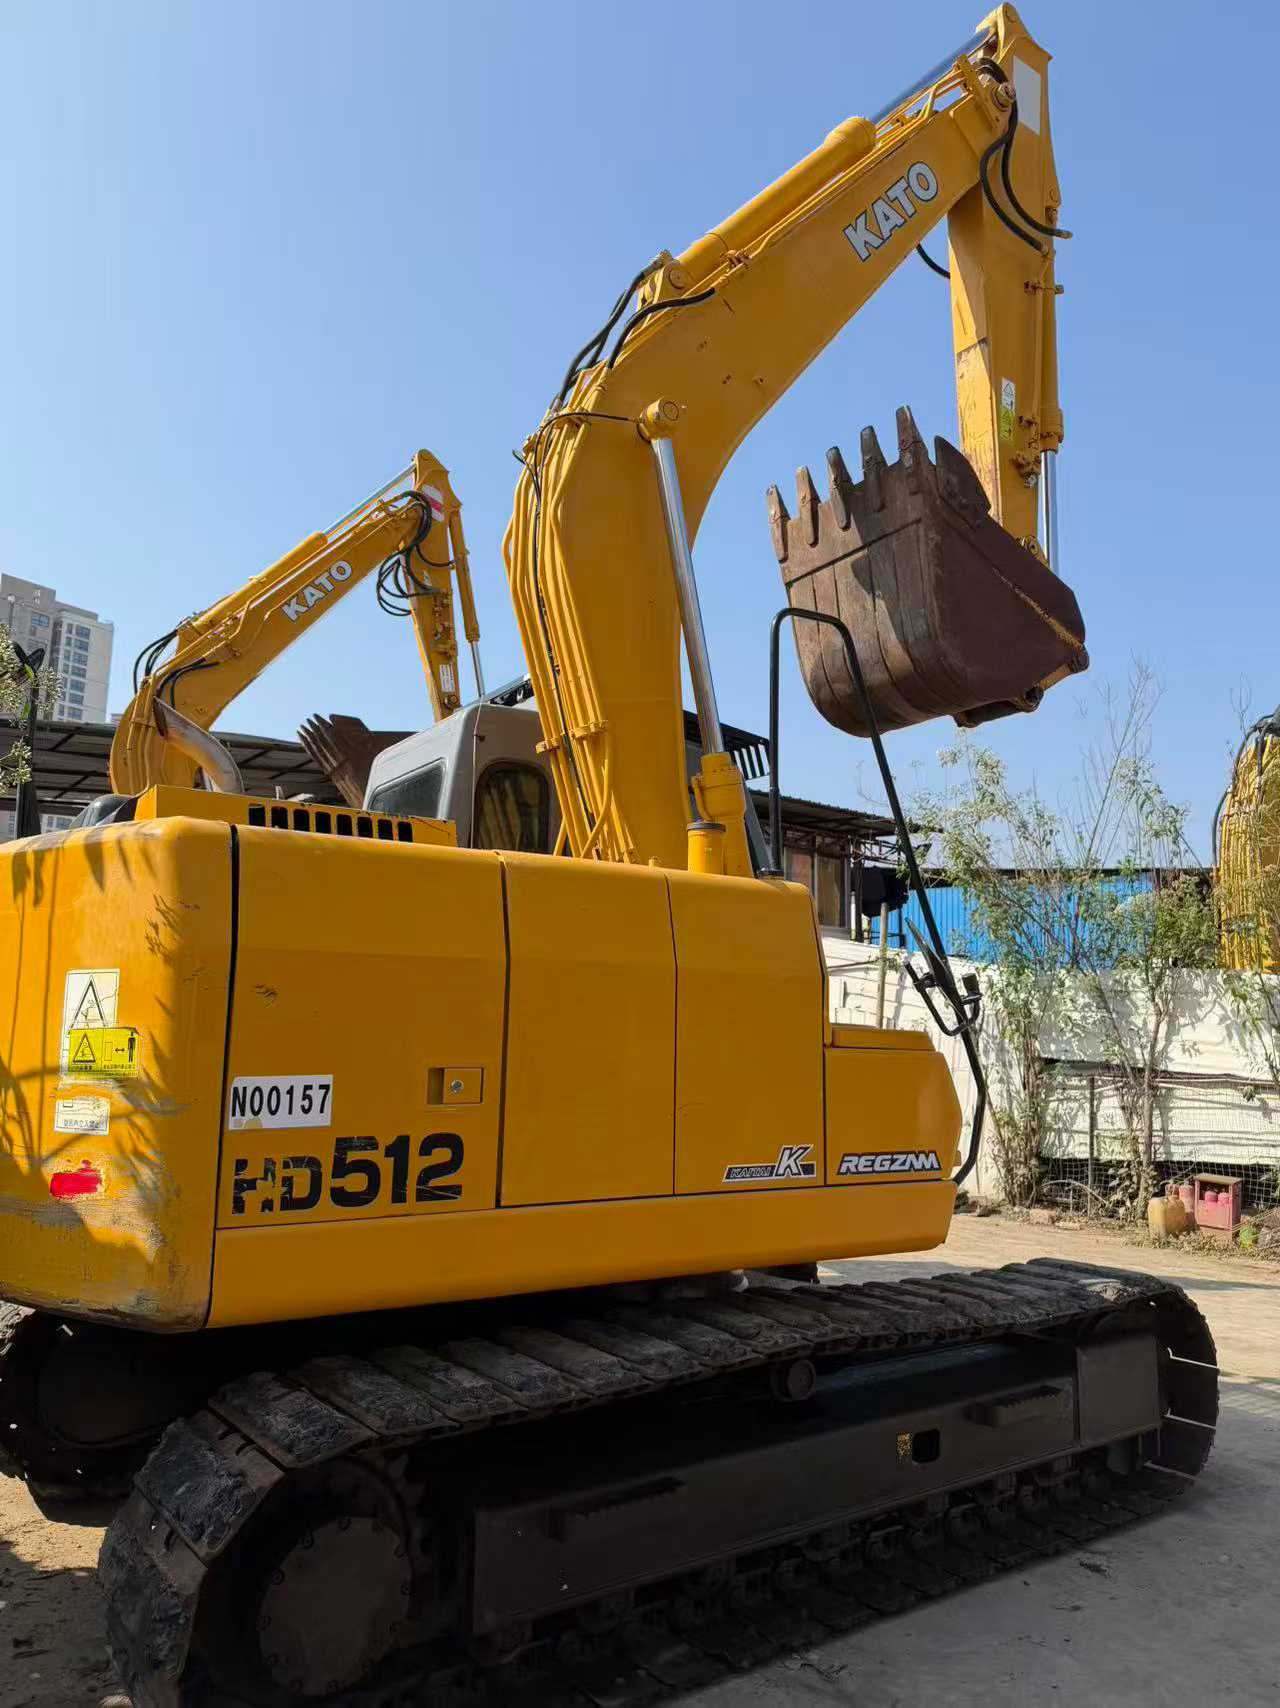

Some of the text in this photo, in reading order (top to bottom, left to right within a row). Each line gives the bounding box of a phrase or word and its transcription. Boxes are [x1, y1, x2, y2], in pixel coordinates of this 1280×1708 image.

[843, 161, 938, 262] KATO
[281, 560, 352, 622] KATO
[232, 1132, 464, 1215] HD512
[776, 1147, 812, 1176] K
